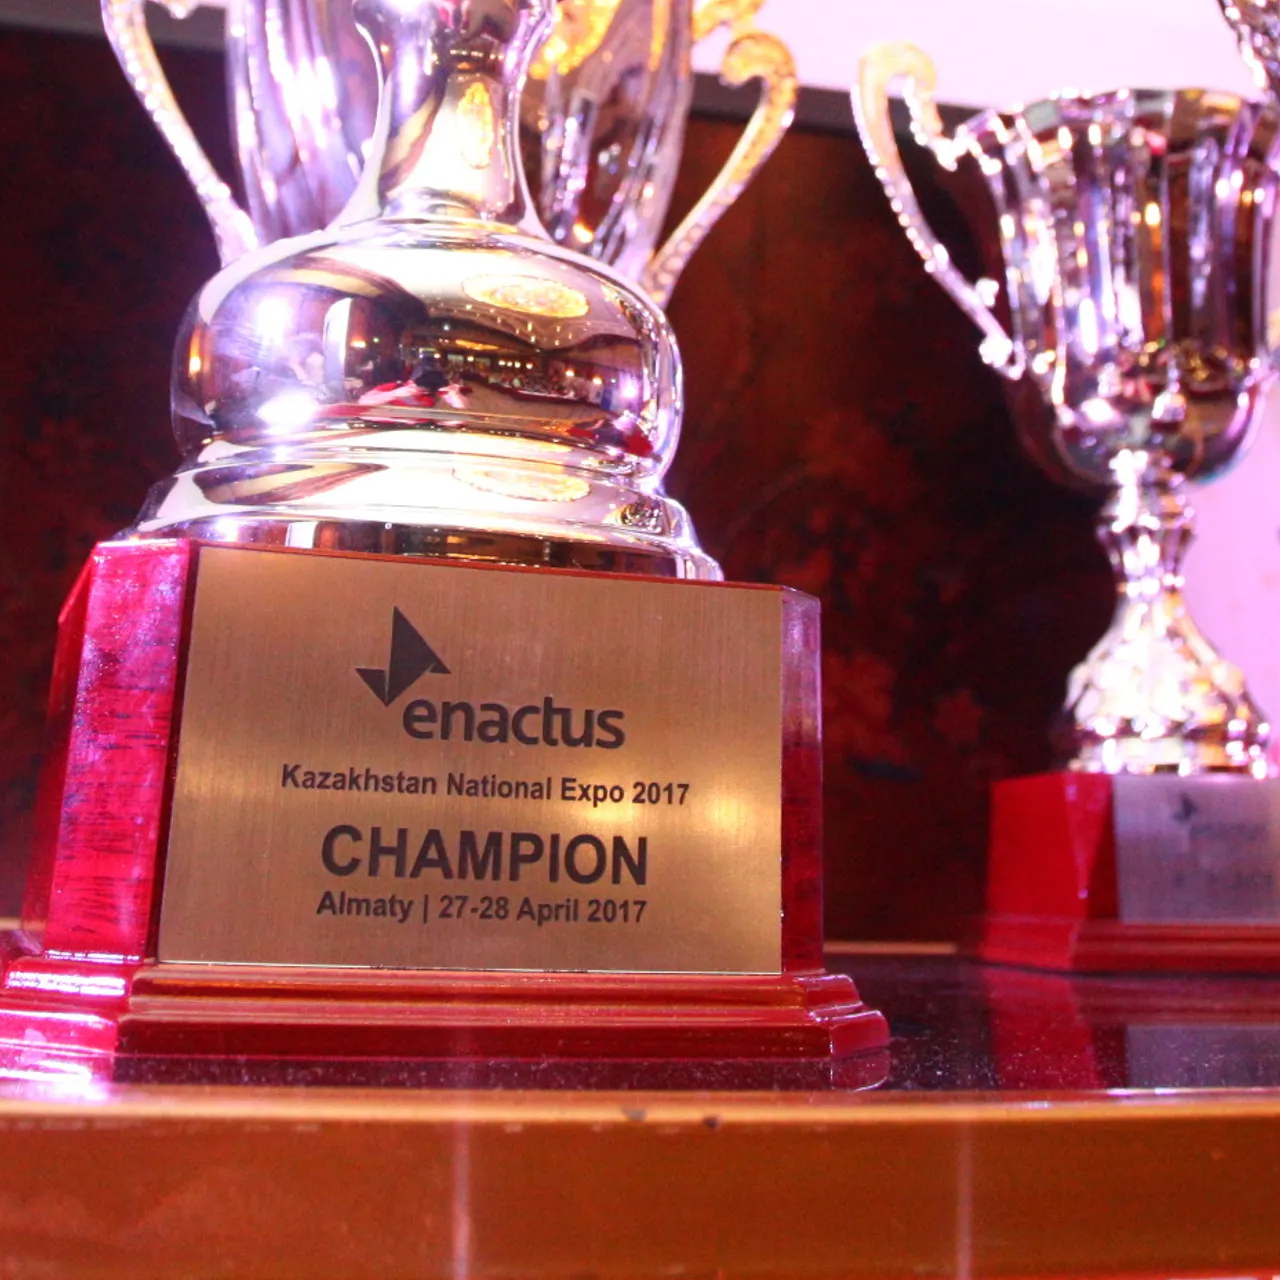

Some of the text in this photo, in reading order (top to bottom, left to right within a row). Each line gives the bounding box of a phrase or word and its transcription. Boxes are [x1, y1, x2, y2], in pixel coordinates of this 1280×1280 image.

[402, 697, 625, 750] enactus
[281, 764, 690, 807] Kazakhstan National Expo 2017
[322, 825, 648, 885] CHAMPION
[317, 891, 414, 923] Almaty
[439, 896, 509, 921] 27-28
[516, 898, 579, 926] April
[587, 900, 647, 923] 2017
